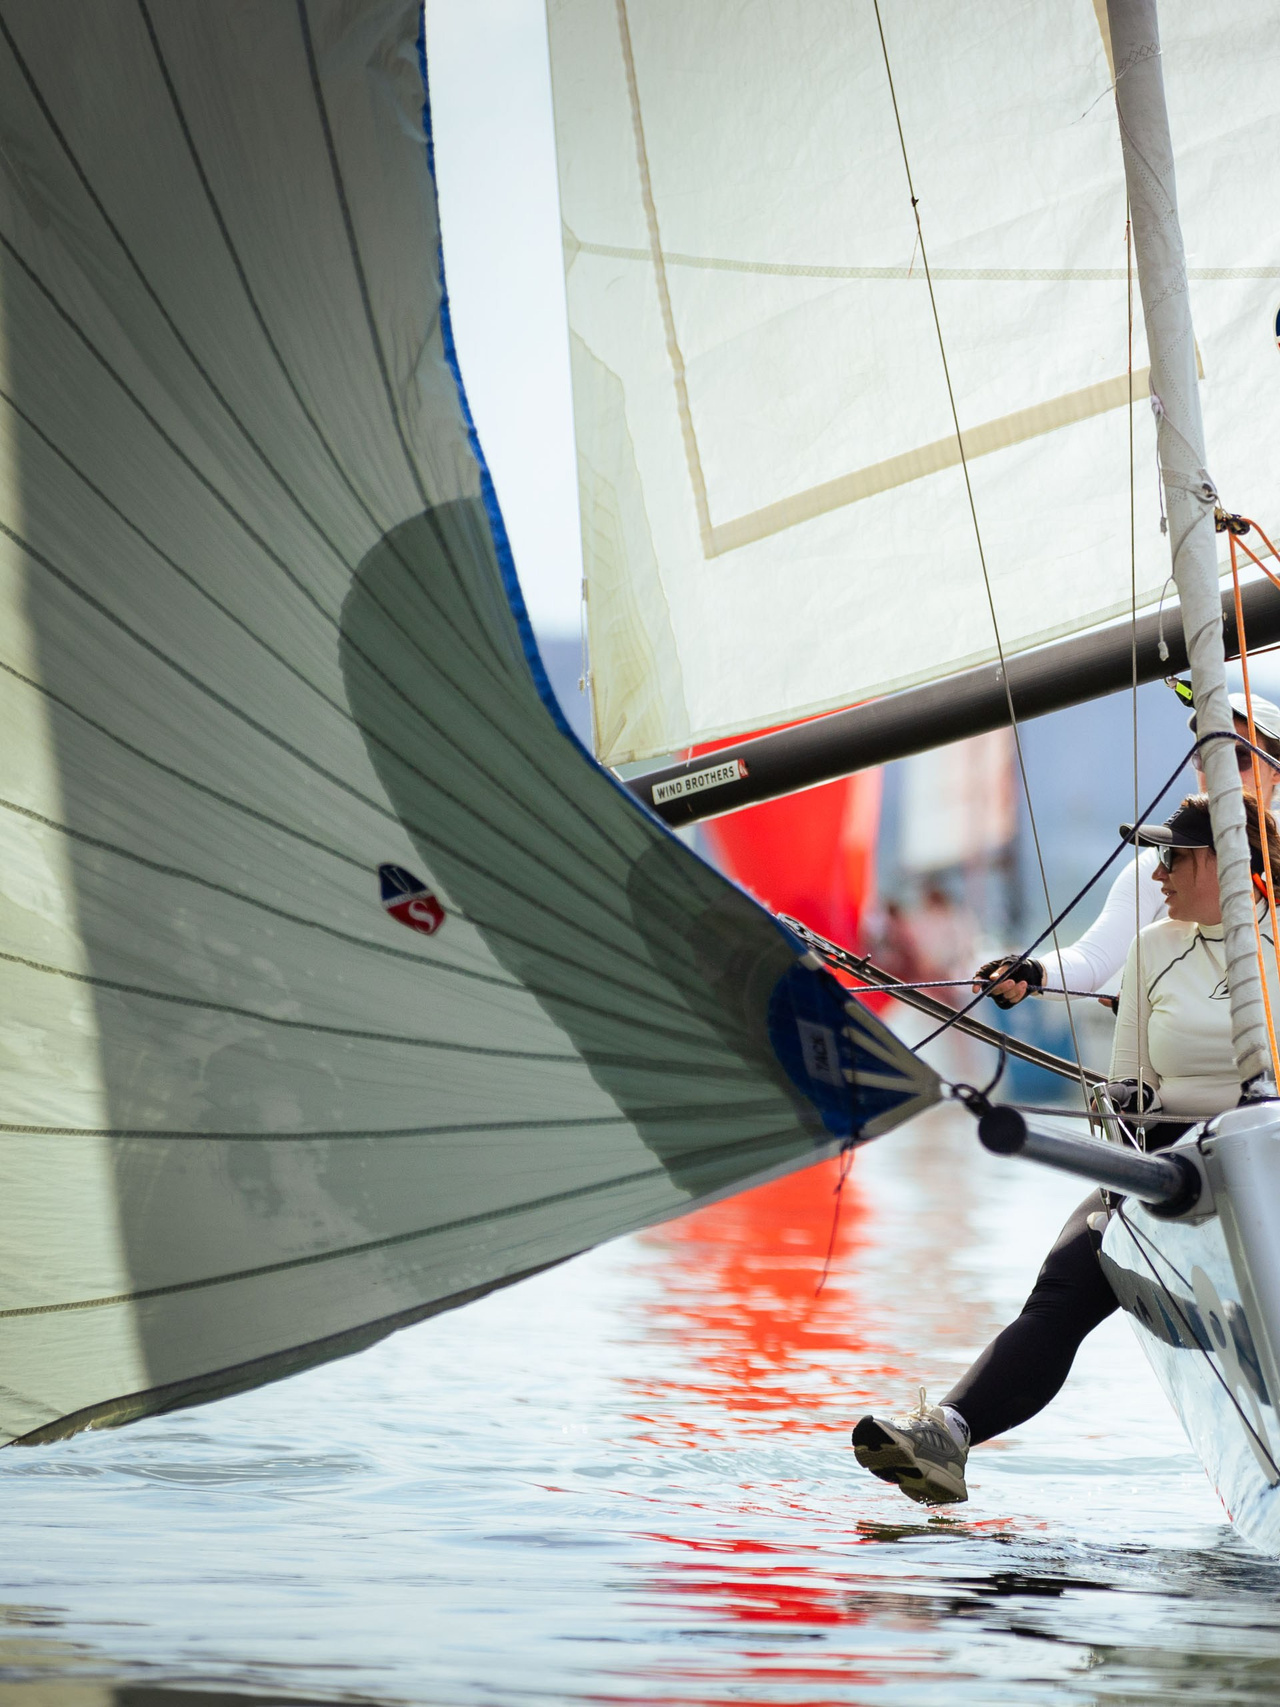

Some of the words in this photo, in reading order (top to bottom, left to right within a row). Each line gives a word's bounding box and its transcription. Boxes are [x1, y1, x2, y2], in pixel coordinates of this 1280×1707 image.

[656, 782, 683, 799] WIND
[685, 765, 735, 791] BROTHERS
[408, 899, 435, 933] S
